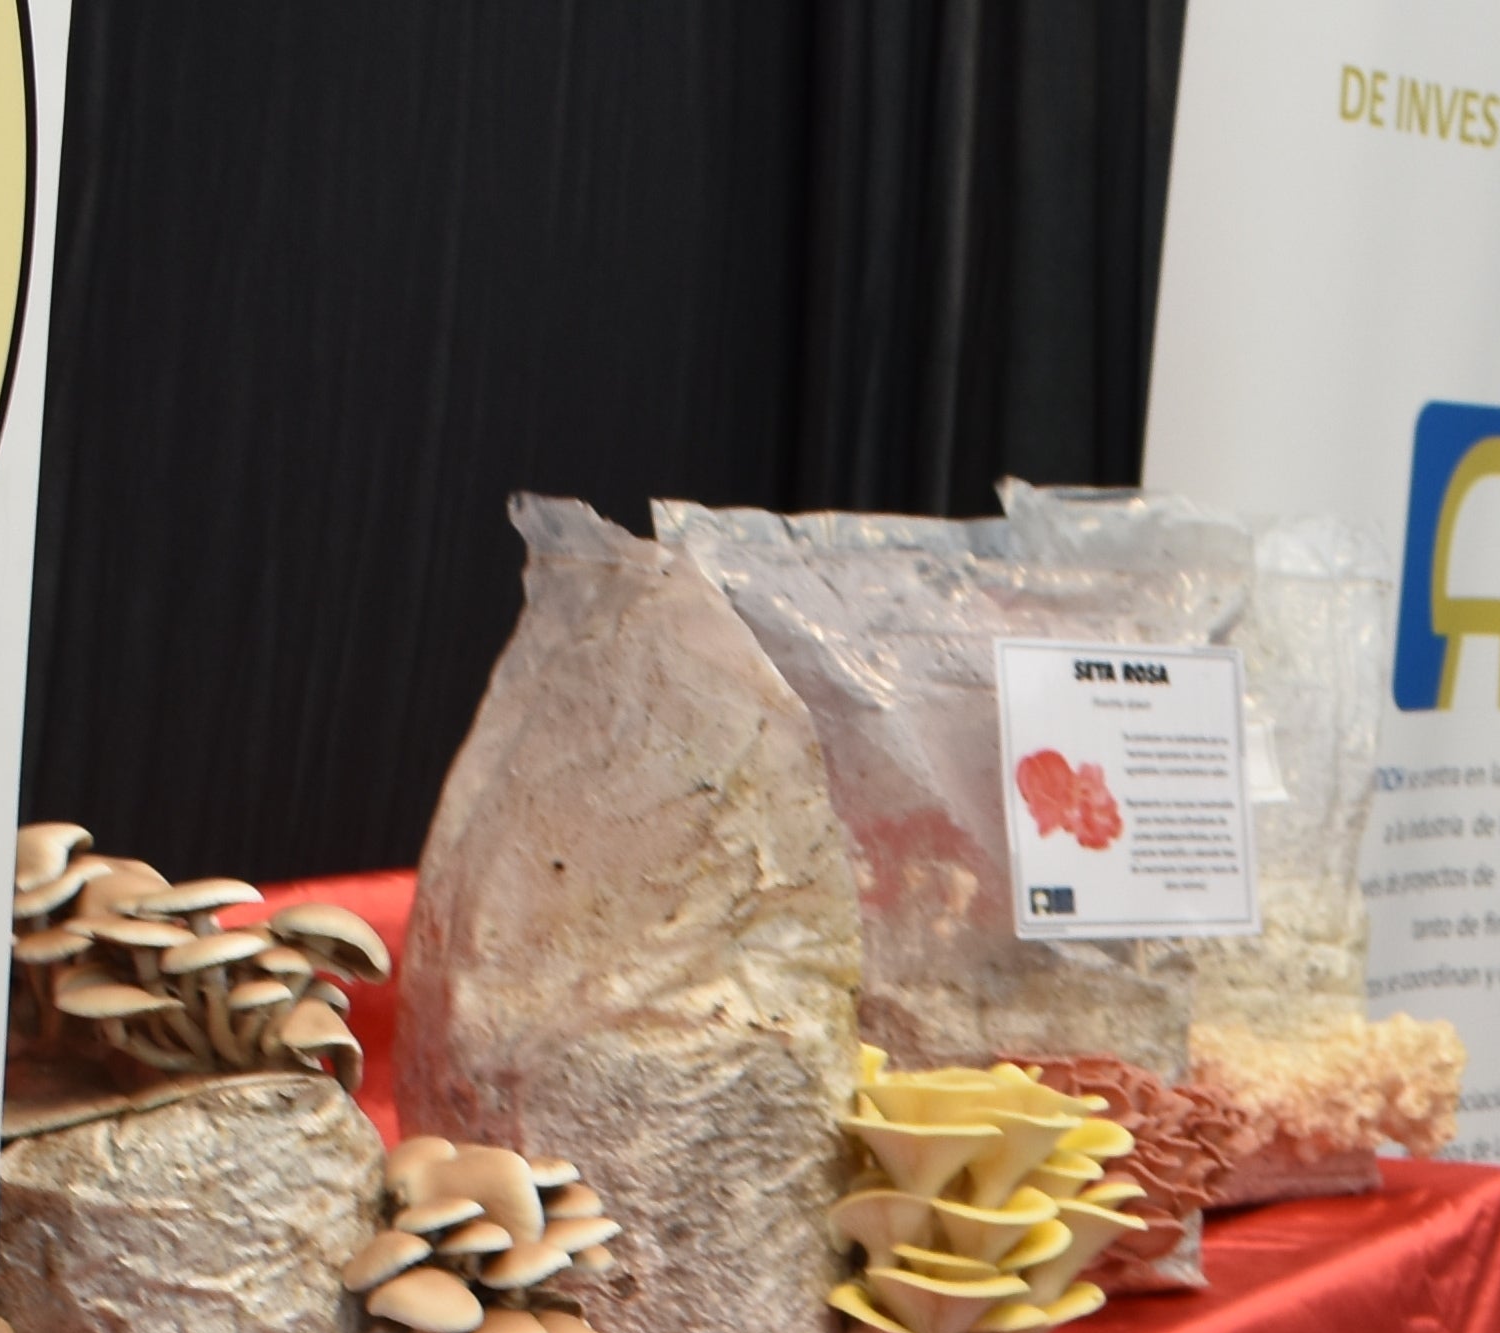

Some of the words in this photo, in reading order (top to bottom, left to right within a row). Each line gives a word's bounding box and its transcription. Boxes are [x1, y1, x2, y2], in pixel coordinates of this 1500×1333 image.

[1339, 64, 1387, 126] DE
[1074, 660, 1116, 682] SETA
[1122, 663, 1170, 684] ROSA
